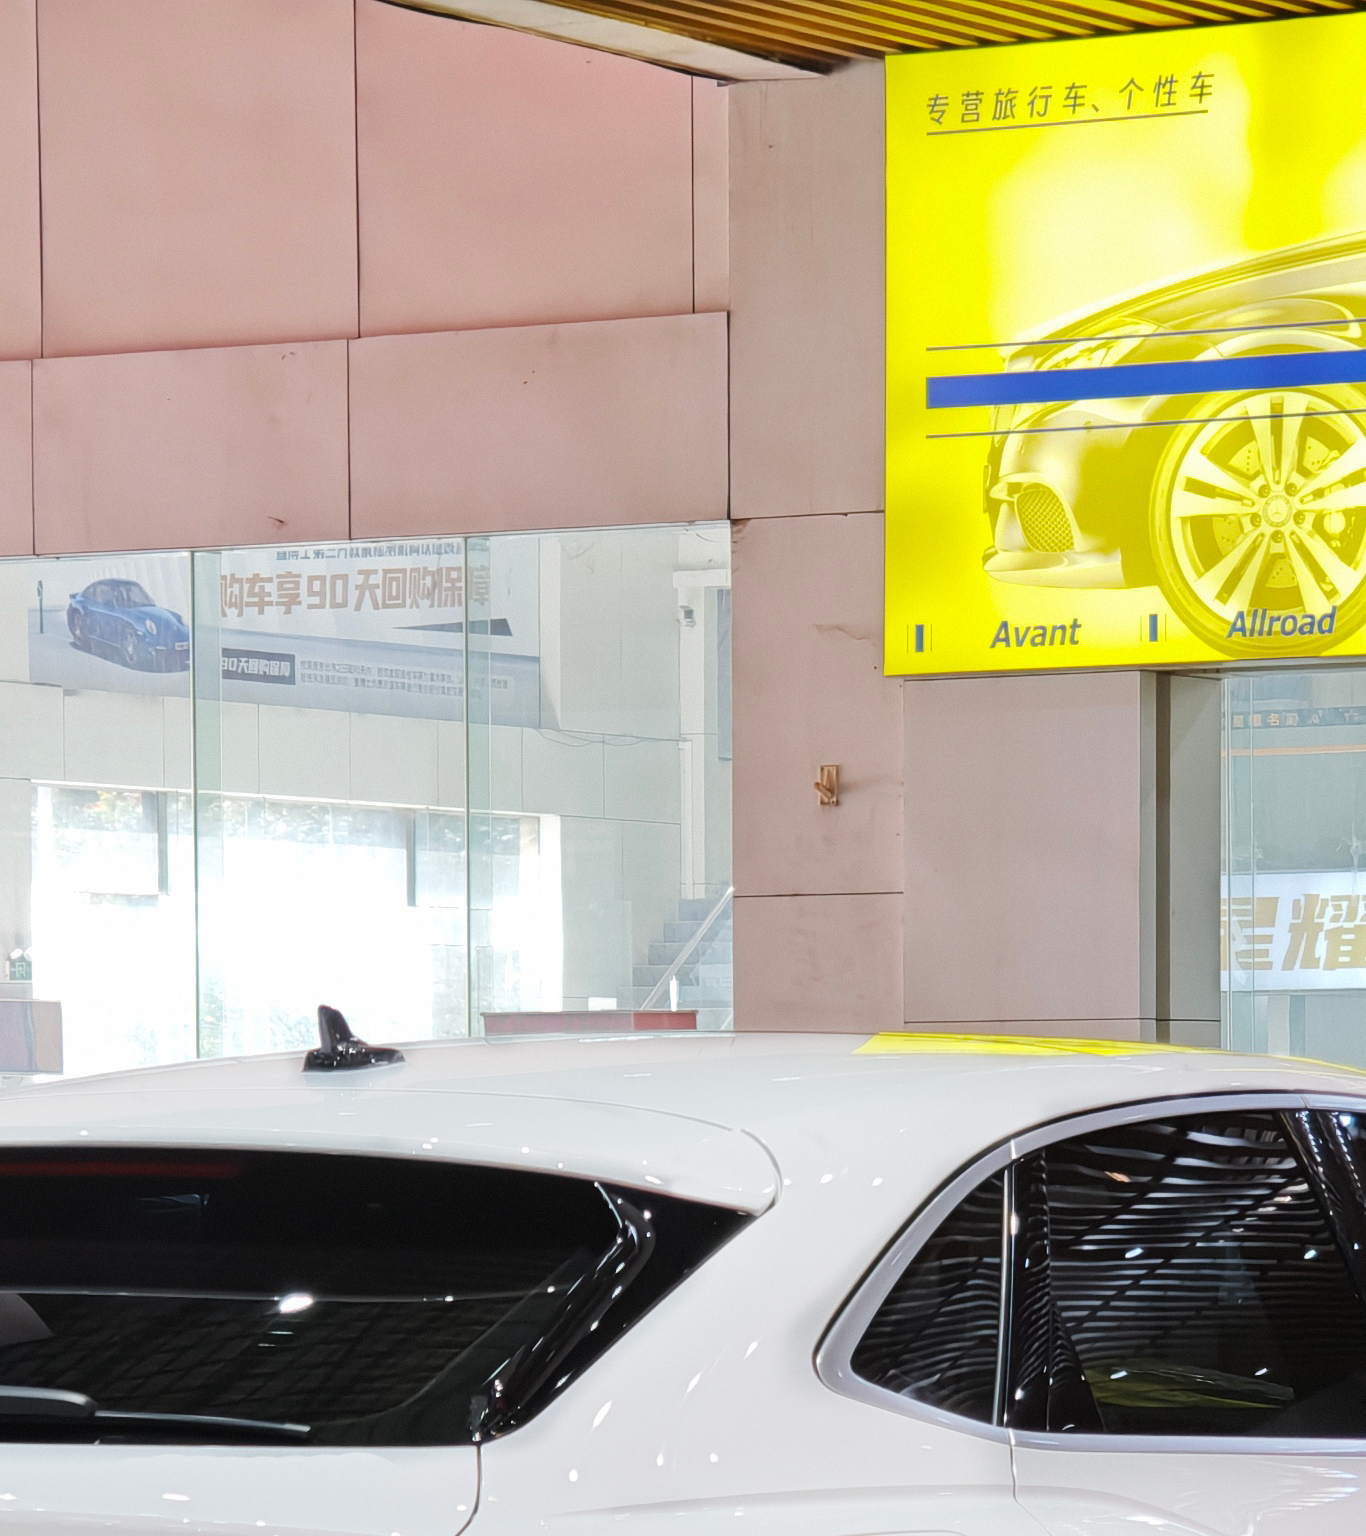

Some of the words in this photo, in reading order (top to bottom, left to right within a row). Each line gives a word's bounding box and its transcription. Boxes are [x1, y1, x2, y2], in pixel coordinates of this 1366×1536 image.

[926, 70, 1215, 125] 专营旅行车、个性车
[989, 618, 1082, 649] Avant
[1226, 605, 1338, 639] Allroad
